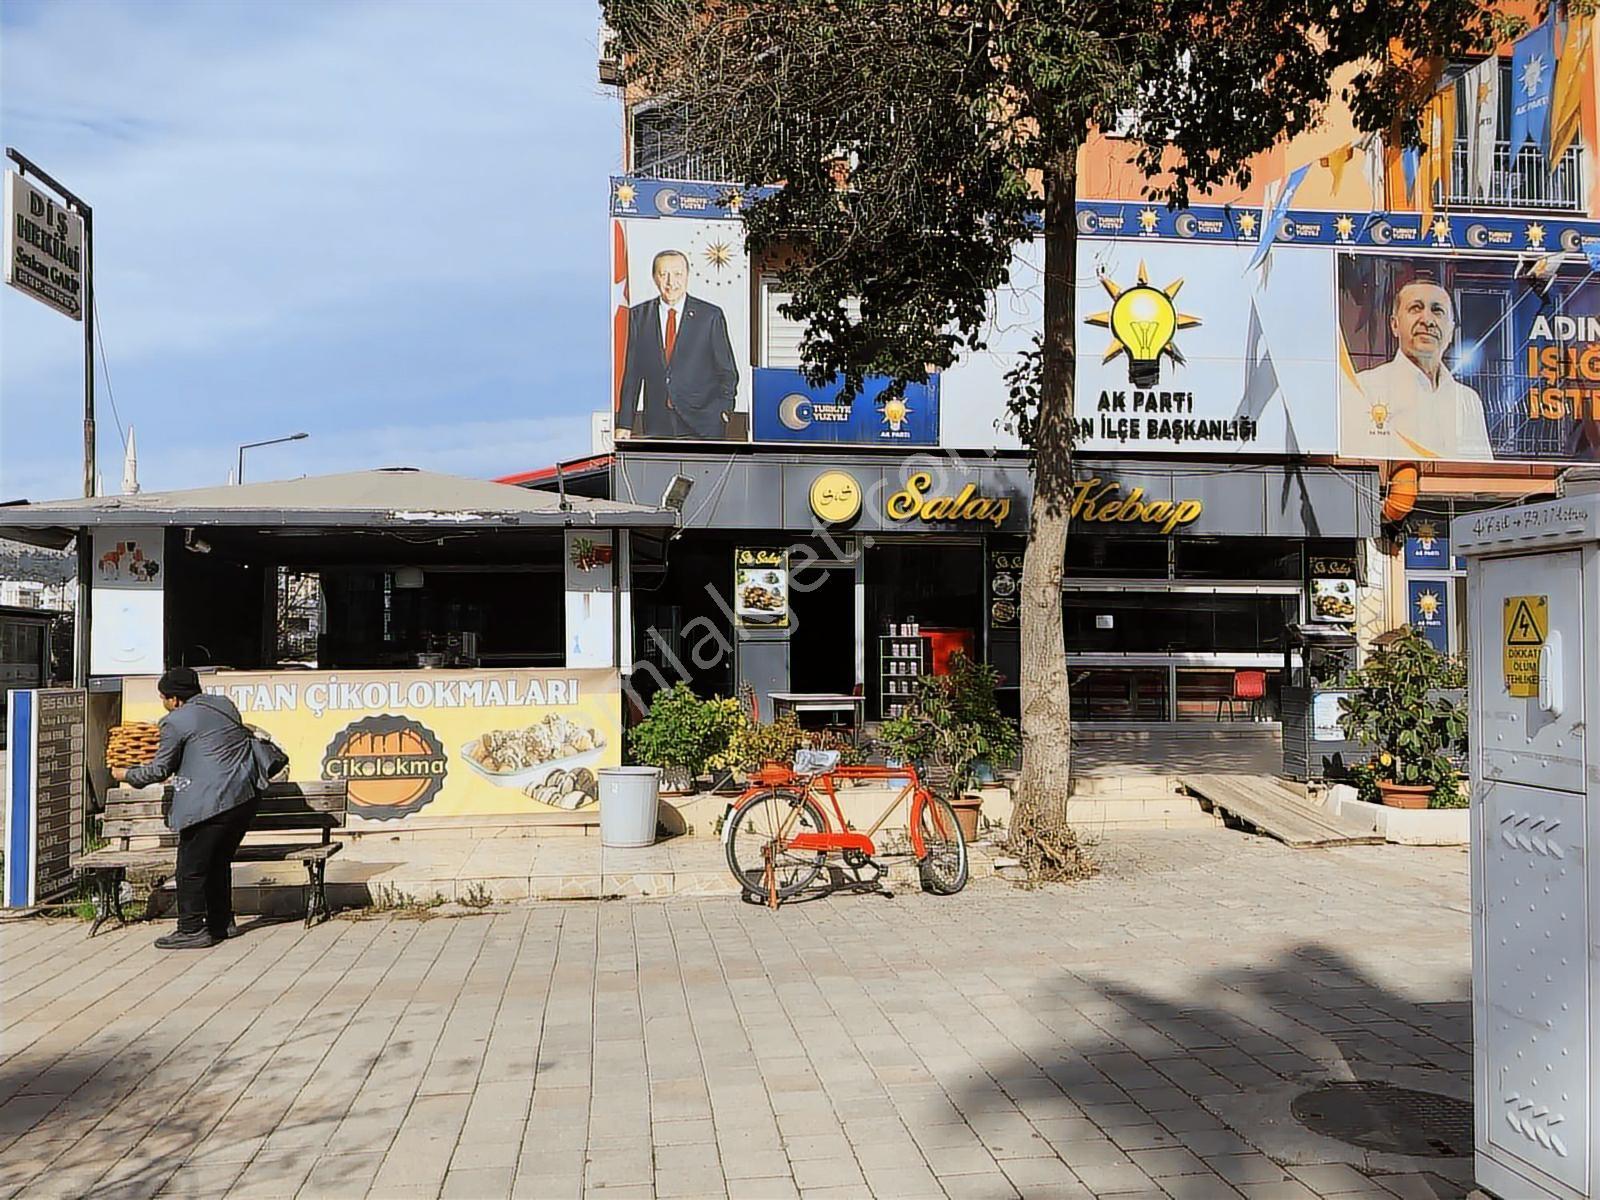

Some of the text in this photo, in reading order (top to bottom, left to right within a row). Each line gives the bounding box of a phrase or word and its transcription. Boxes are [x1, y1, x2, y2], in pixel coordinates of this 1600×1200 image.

[1097, 391, 1193, 413] AK PARTİ
[1100, 414, 1140, 443] İLÇE
[1146, 416, 1258, 445] BAŞKANLIĞI
[886, 471, 1203, 535] Salaş Kebap
[304, 675, 579, 718] ÇİKOLOKMALARI
[325, 757, 445, 781] Çikolokma
